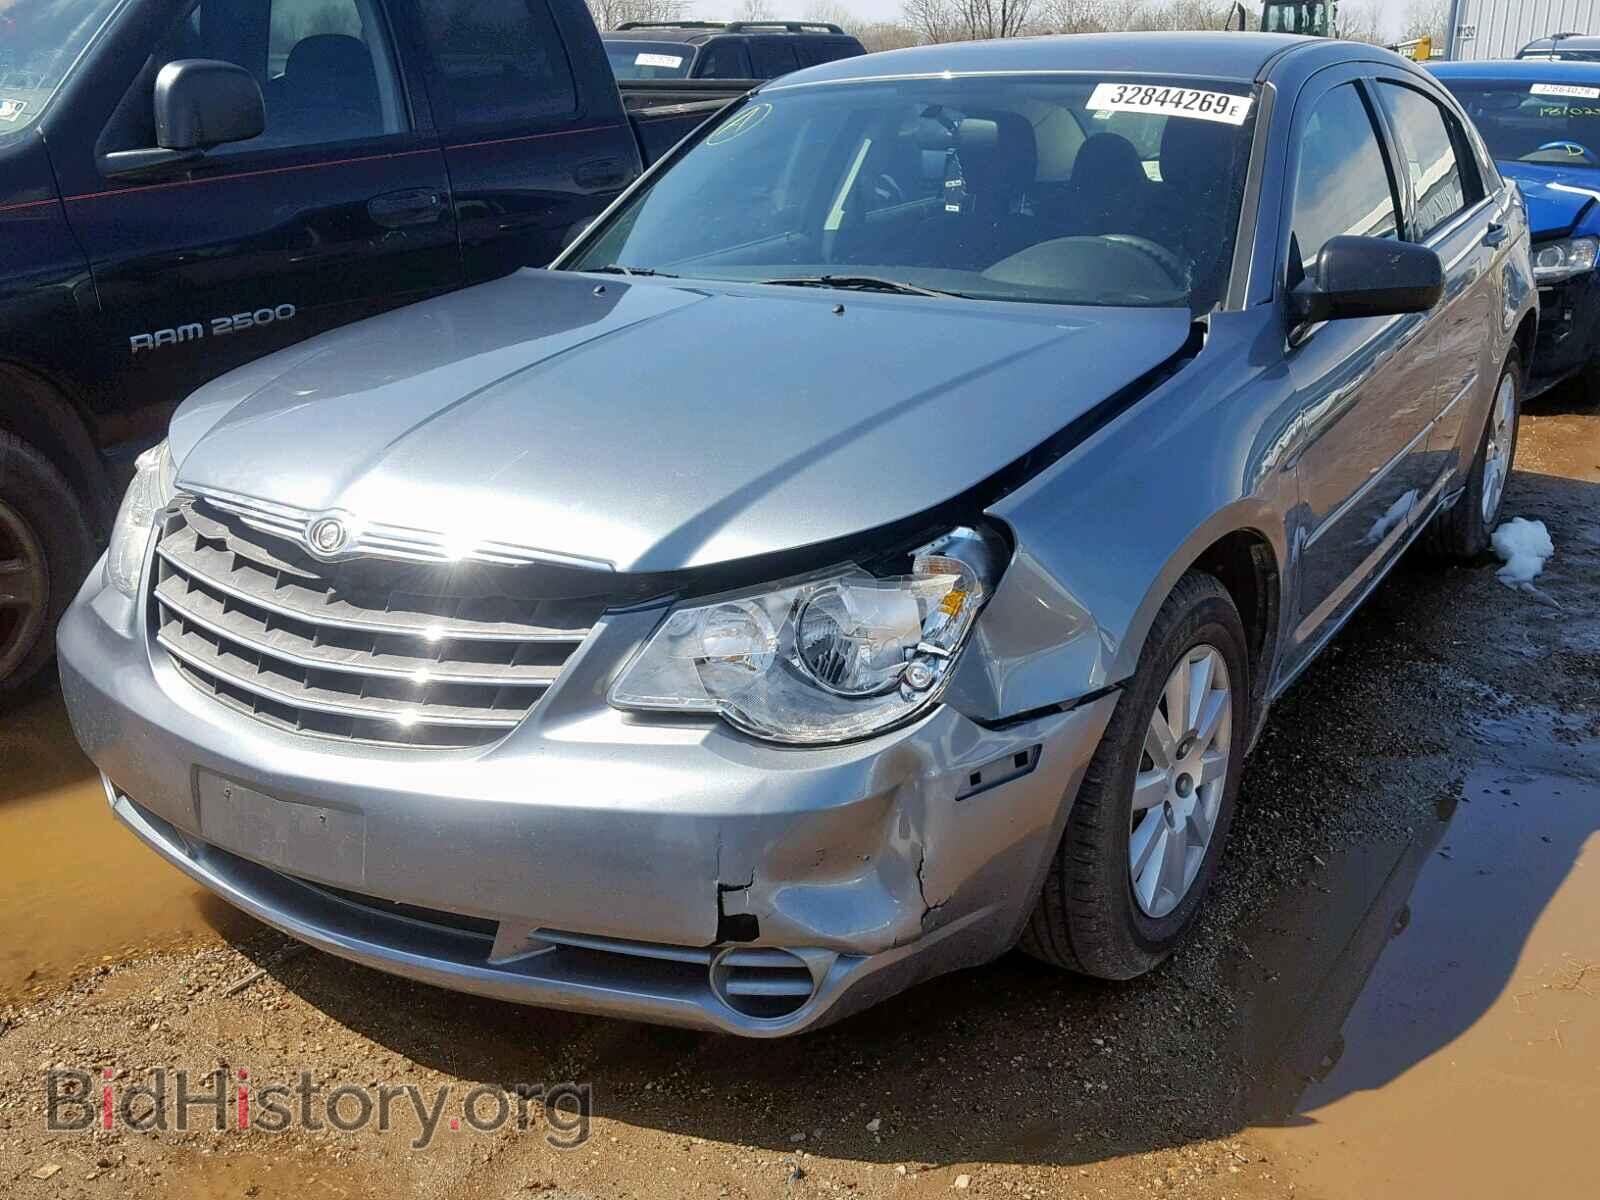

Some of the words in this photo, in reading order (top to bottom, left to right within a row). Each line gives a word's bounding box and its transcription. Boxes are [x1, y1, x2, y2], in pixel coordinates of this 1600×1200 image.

[1110, 85, 1230, 114] 32844269
[1229, 105, 1239, 116] E
[129, 323, 203, 352] RAM
[210, 304, 296, 335] 2500
